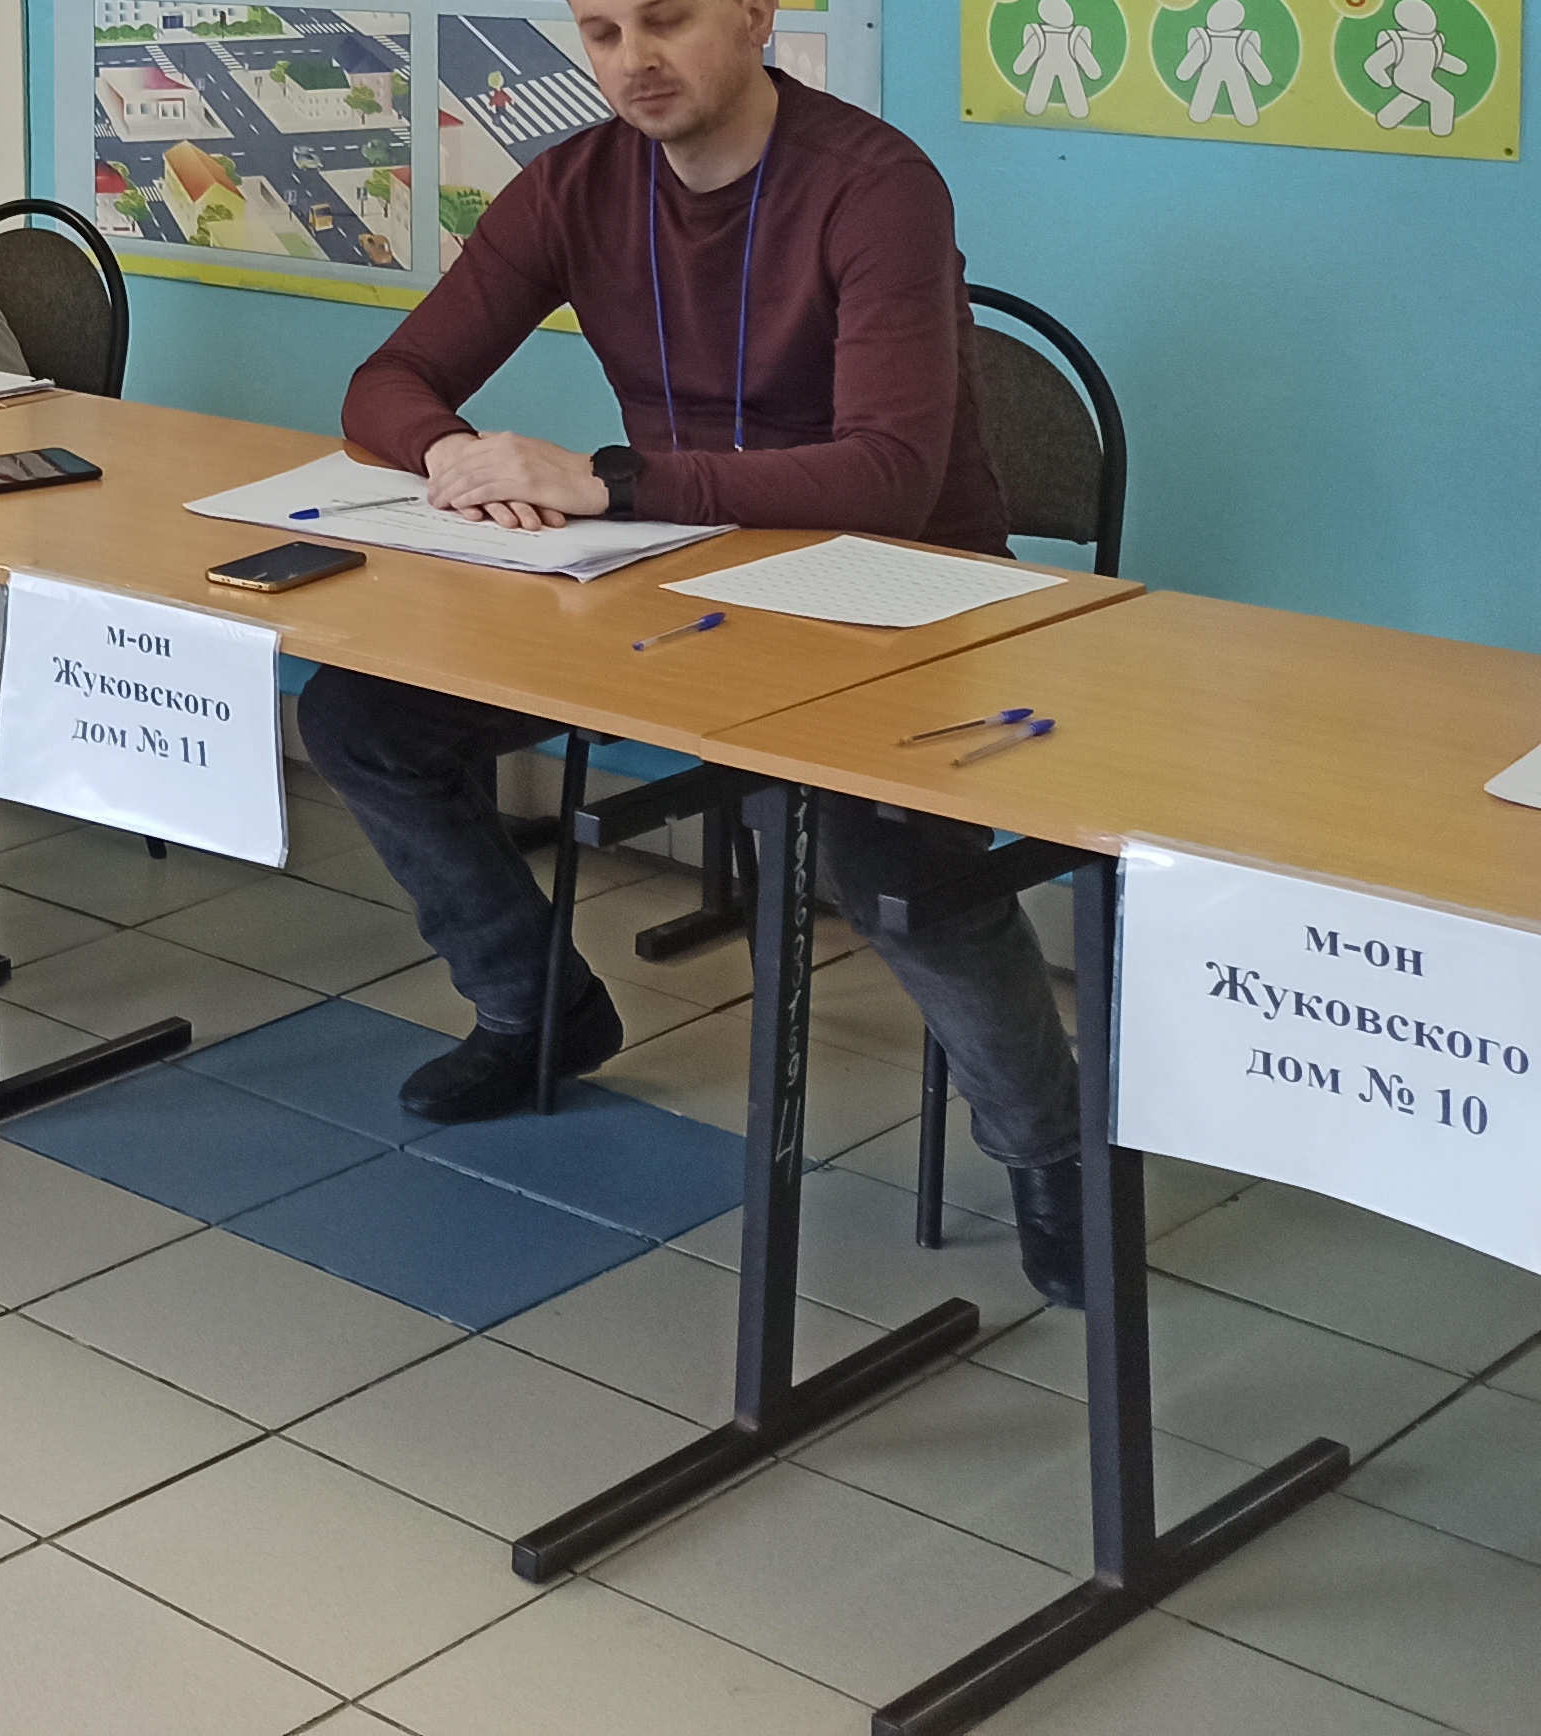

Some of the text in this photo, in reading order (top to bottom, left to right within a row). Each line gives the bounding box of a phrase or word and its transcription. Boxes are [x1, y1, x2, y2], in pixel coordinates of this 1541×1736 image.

[106, 625, 172, 658] м-он
[52, 656, 231, 722] Жуковского
[71, 719, 210, 768] дом № 11
[1304, 924, 1425, 979] м-он
[1205, 959, 1530, 1077] Жуковского
[1245, 1047, 1489, 1136] дом № 10
